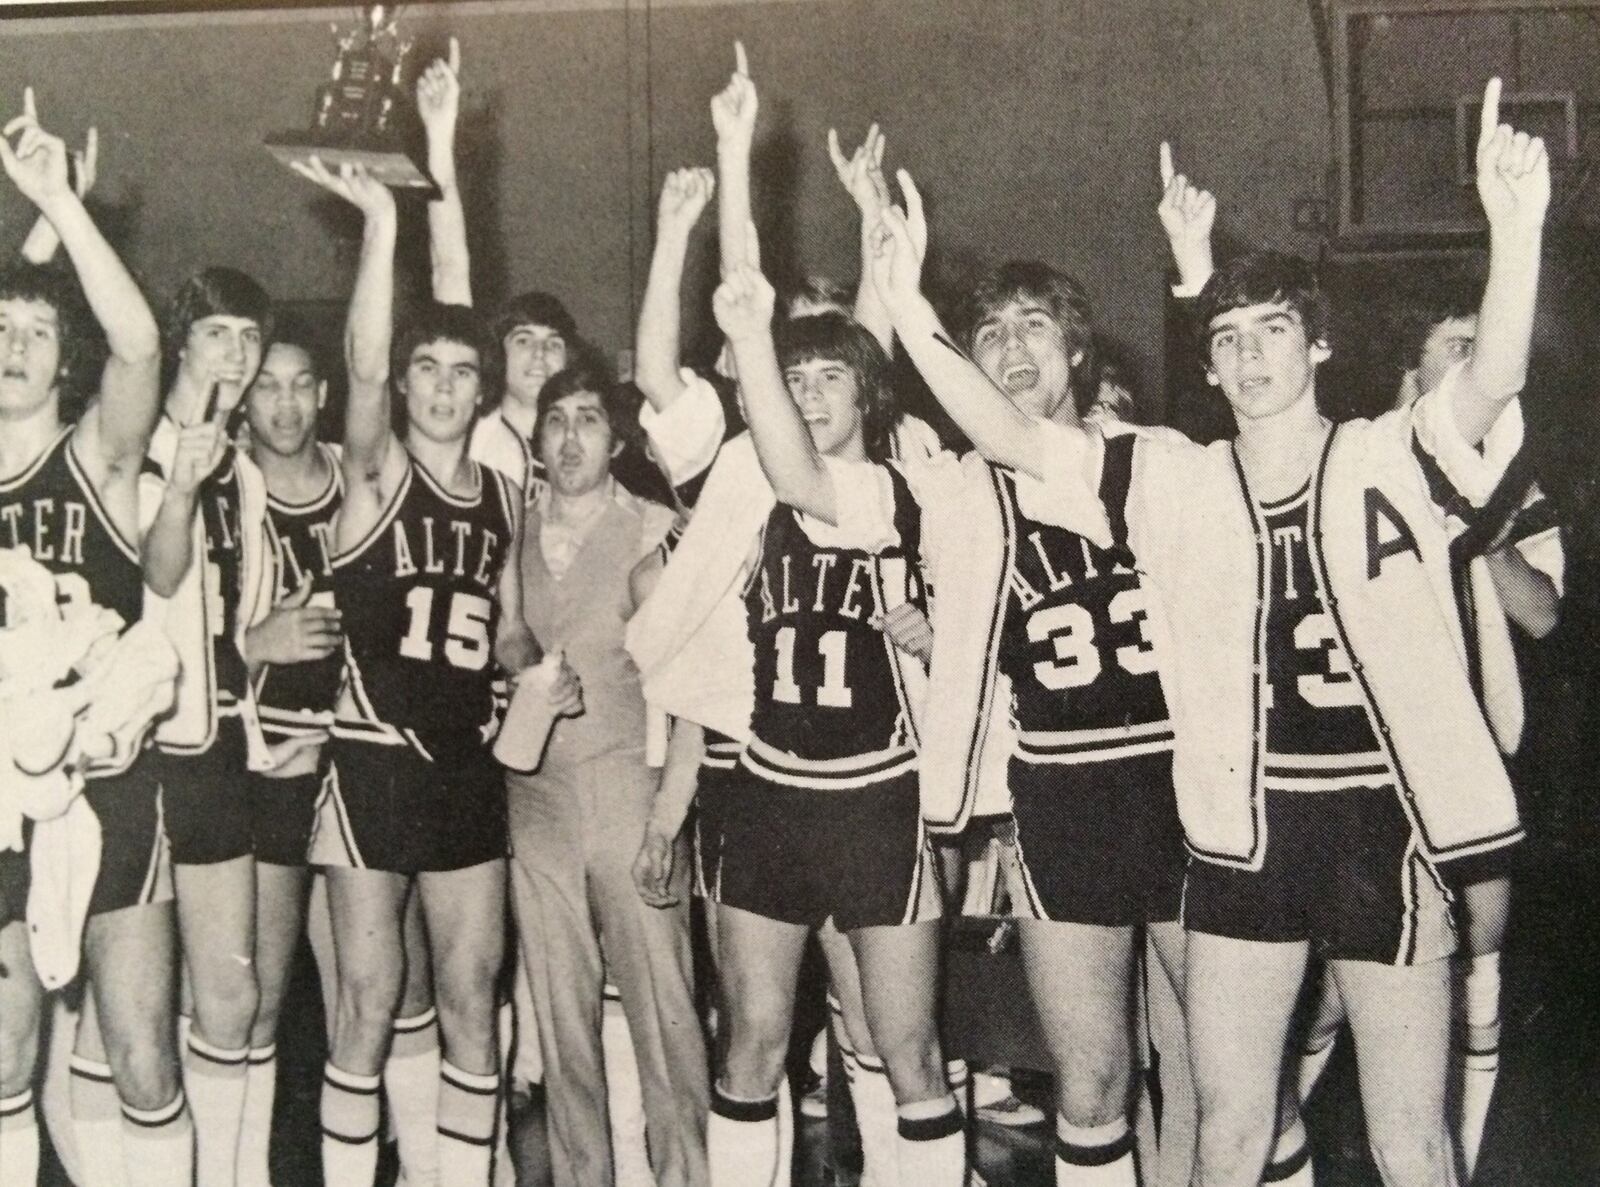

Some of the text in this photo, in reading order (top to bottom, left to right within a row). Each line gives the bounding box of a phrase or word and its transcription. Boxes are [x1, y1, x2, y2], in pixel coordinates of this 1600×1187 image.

[1, 498, 85, 564] TER
[1363, 486, 1424, 581] A
[400, 586, 492, 671] 15
[772, 626, 853, 708] 11
